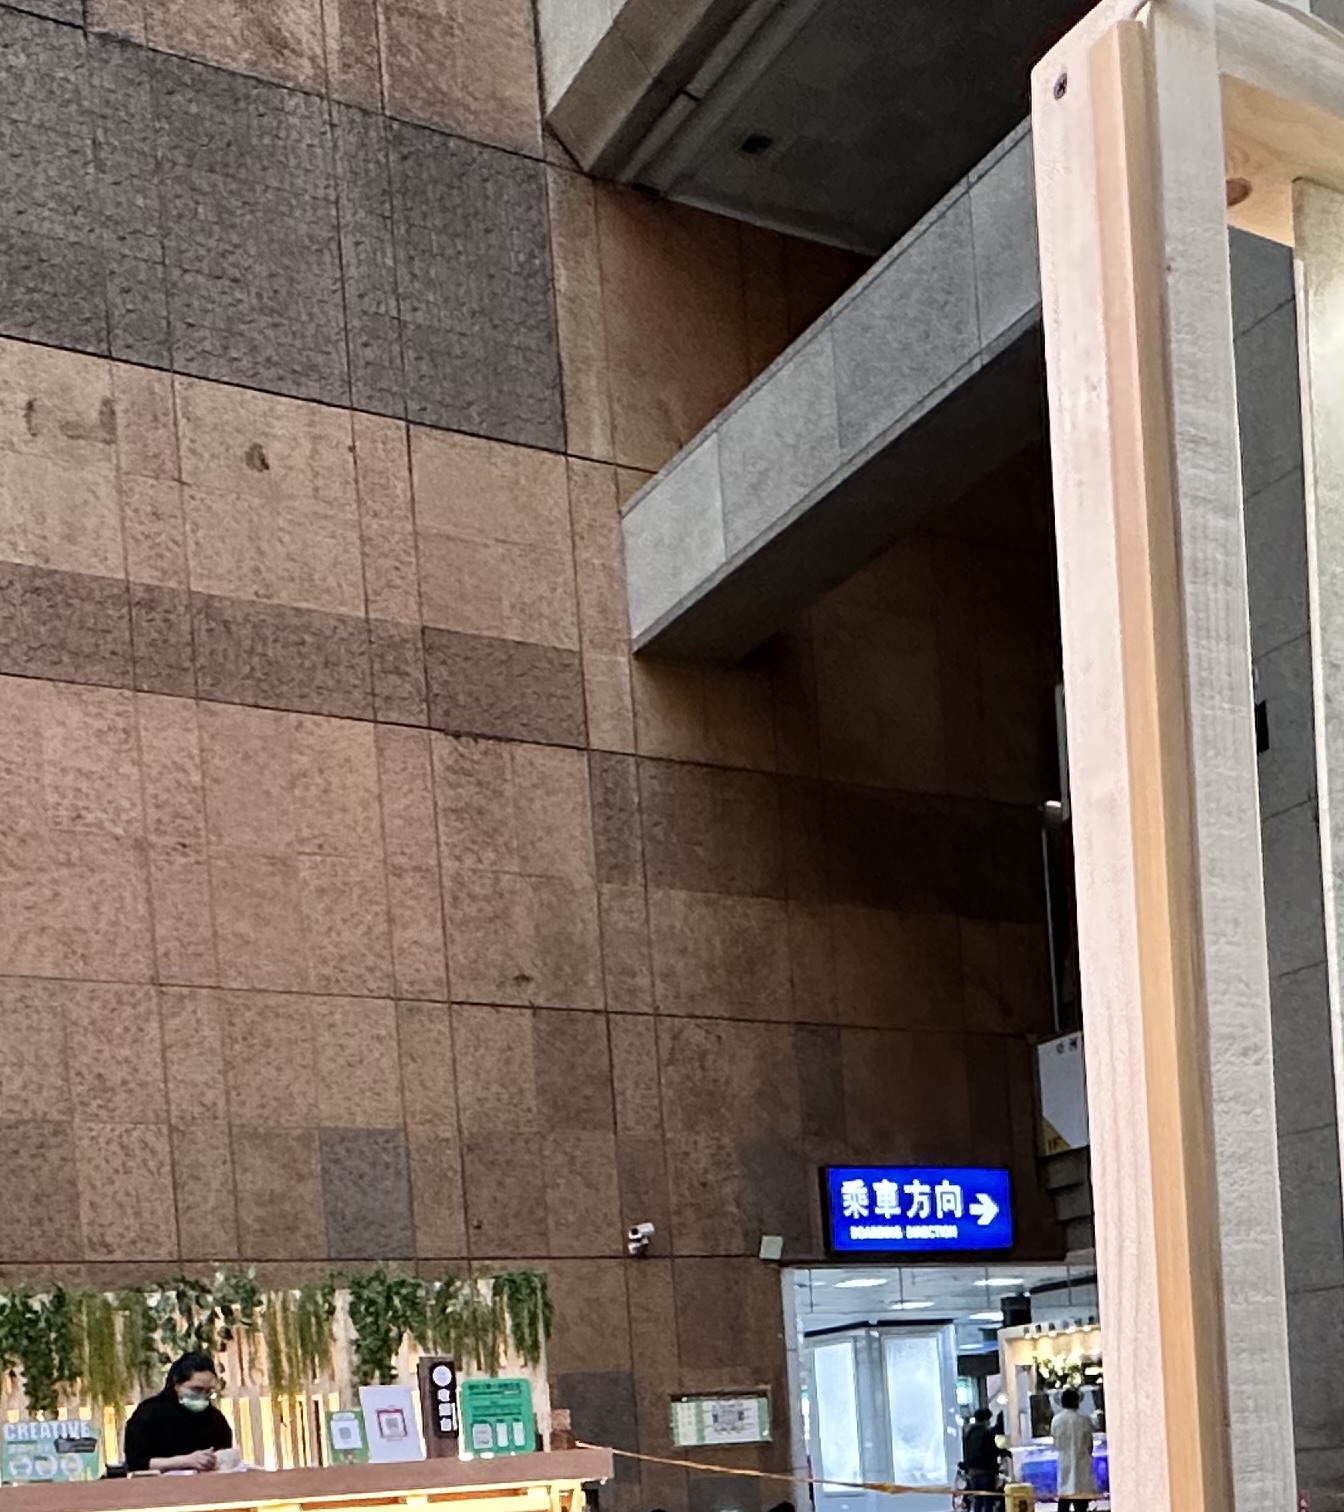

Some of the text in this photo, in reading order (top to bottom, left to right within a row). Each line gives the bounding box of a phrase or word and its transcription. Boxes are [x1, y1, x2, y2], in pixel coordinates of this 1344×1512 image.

[840, 1178, 964, 1219] 乘車方向
[3, 1421, 90, 1440] CREATIVE
